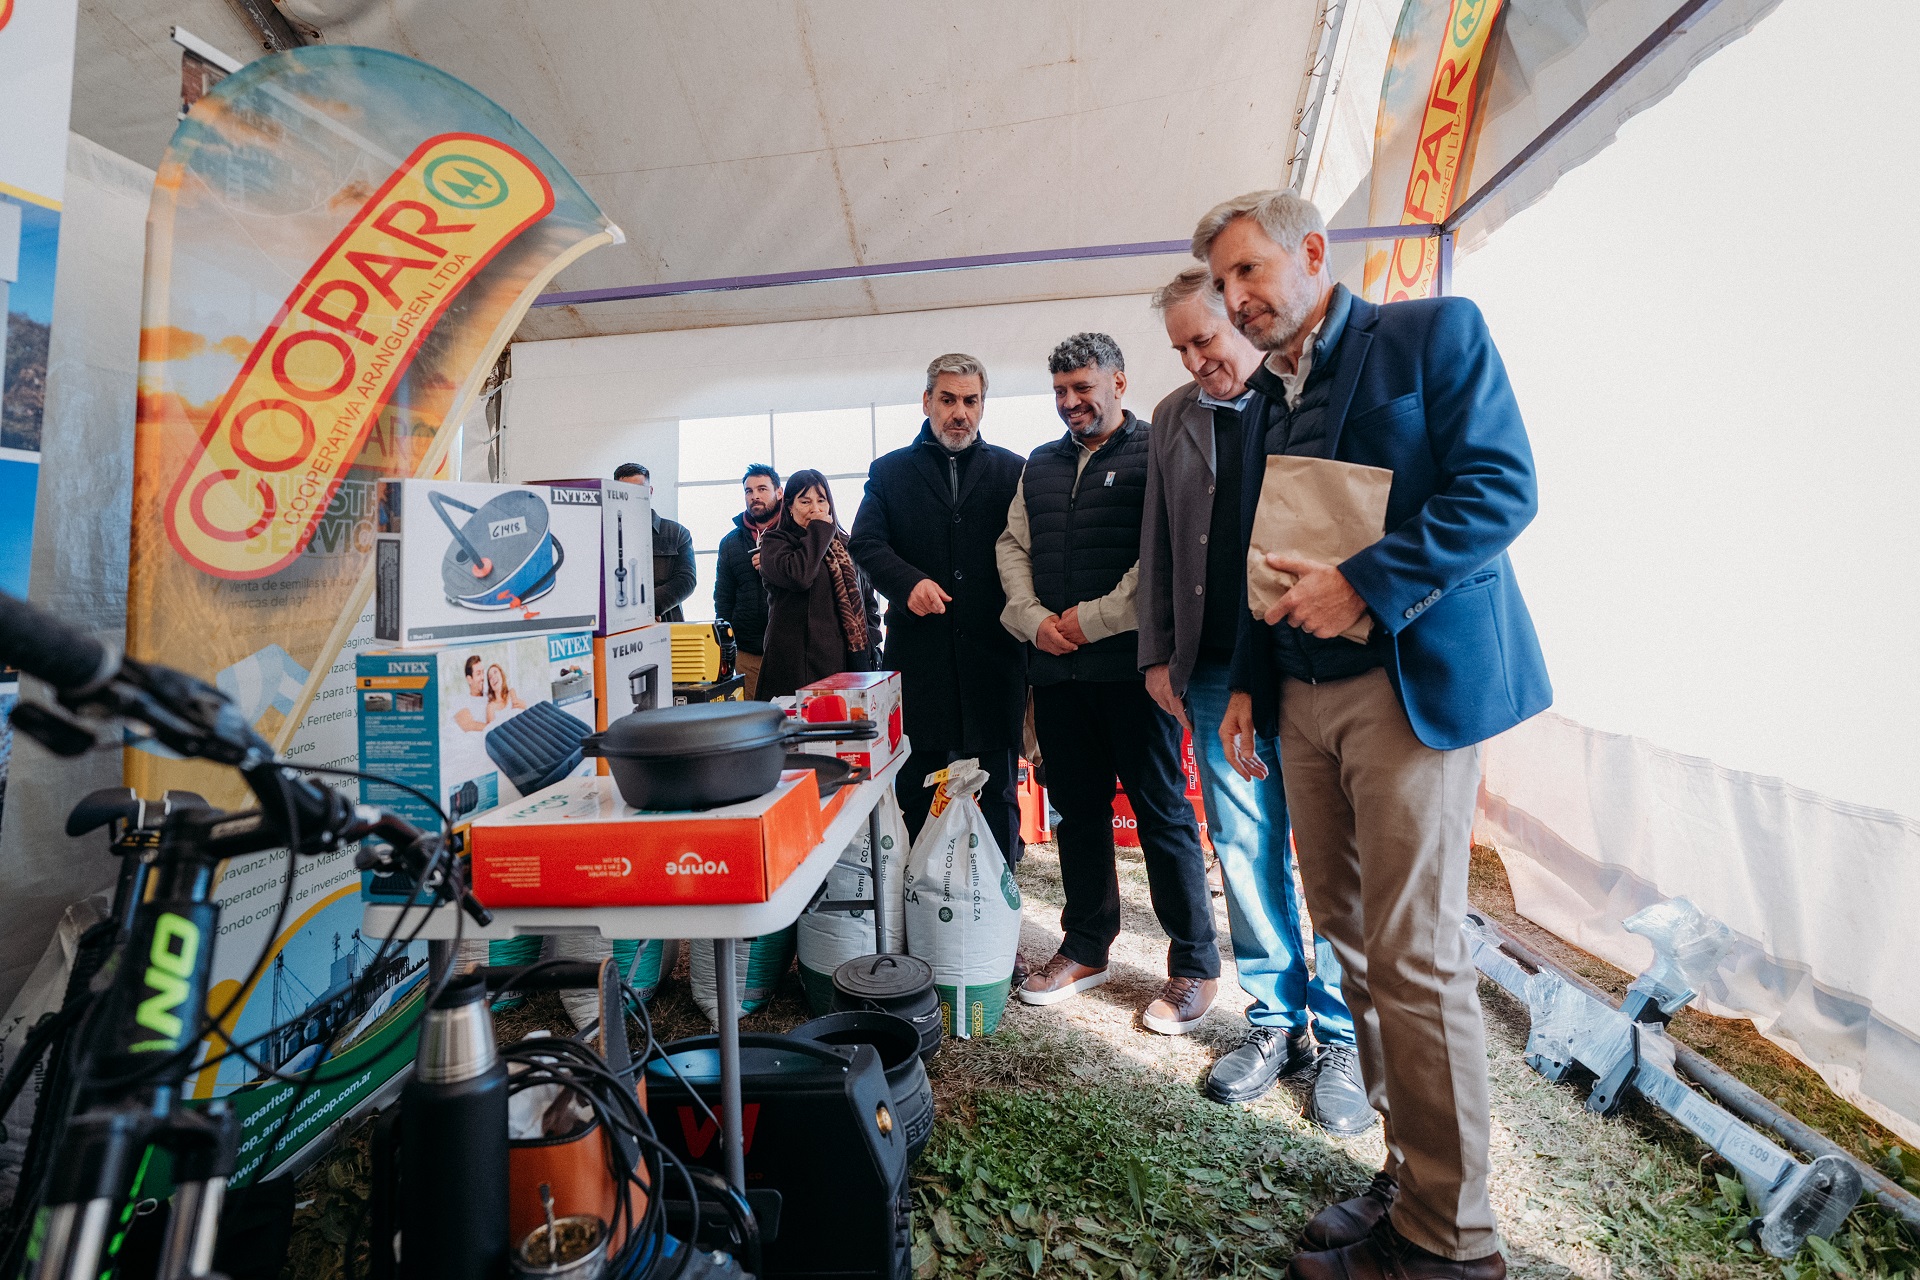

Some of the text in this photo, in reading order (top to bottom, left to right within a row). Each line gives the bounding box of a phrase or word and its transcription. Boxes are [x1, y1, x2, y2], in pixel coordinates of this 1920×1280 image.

[189, 199, 476, 542] COOPAR
[283, 250, 472, 526] COOPERATIVA ARANGUREN LTDA
[553, 488, 599, 504] INTEX
[607, 489, 629, 501] YELMO
[262, 580, 277, 591] de
[550, 636, 591, 659] INTEX
[612, 640, 644, 659] YELMO
[388, 661, 430, 673] INTEX
[322, 687, 344, 702] para
[345, 685, 357, 694] tra
[1187, 739, 1195, 774] FUEL
[860, 832, 871, 863] COLZA
[665, 859, 729, 875] vonne
[943, 838, 957, 902] Semilla COLZA
[295, 888, 310, 903] de
[970, 852, 981, 922] Semilla COLZA
[241, 1086, 294, 1129] oparltda
